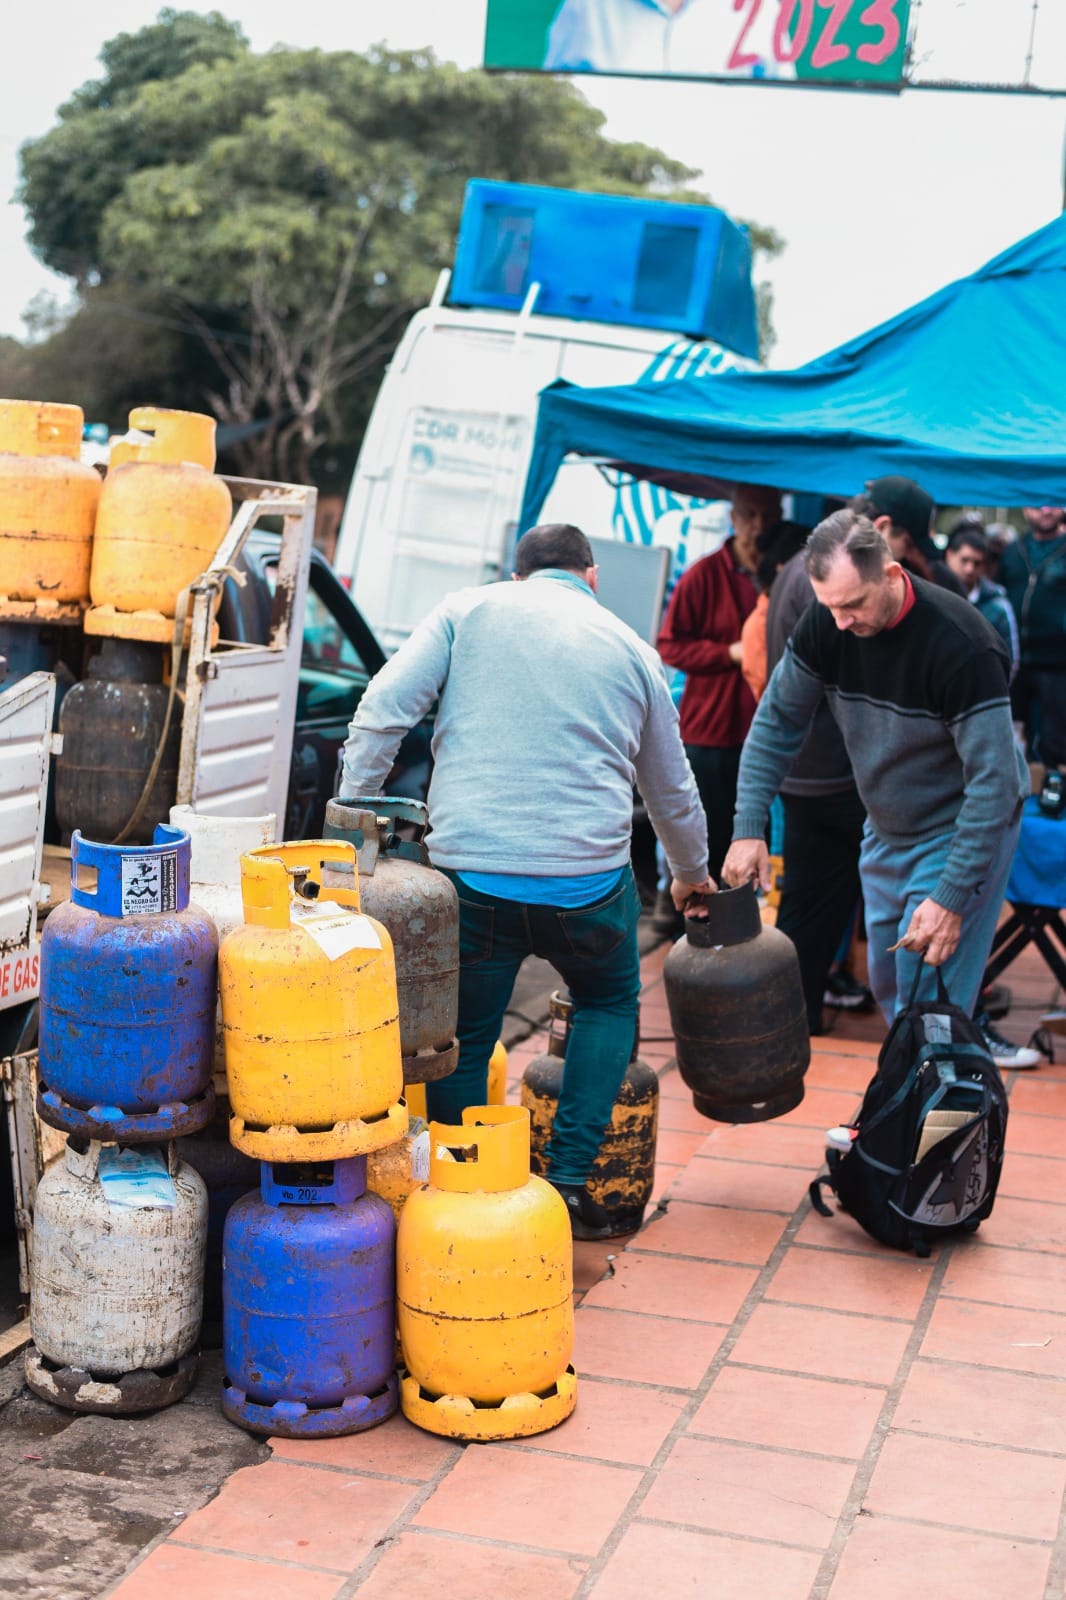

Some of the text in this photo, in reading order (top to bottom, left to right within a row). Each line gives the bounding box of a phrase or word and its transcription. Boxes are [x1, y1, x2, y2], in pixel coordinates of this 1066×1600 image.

[727, 0, 900, 69] 2023
[0, 955, 39, 997] E GAS
